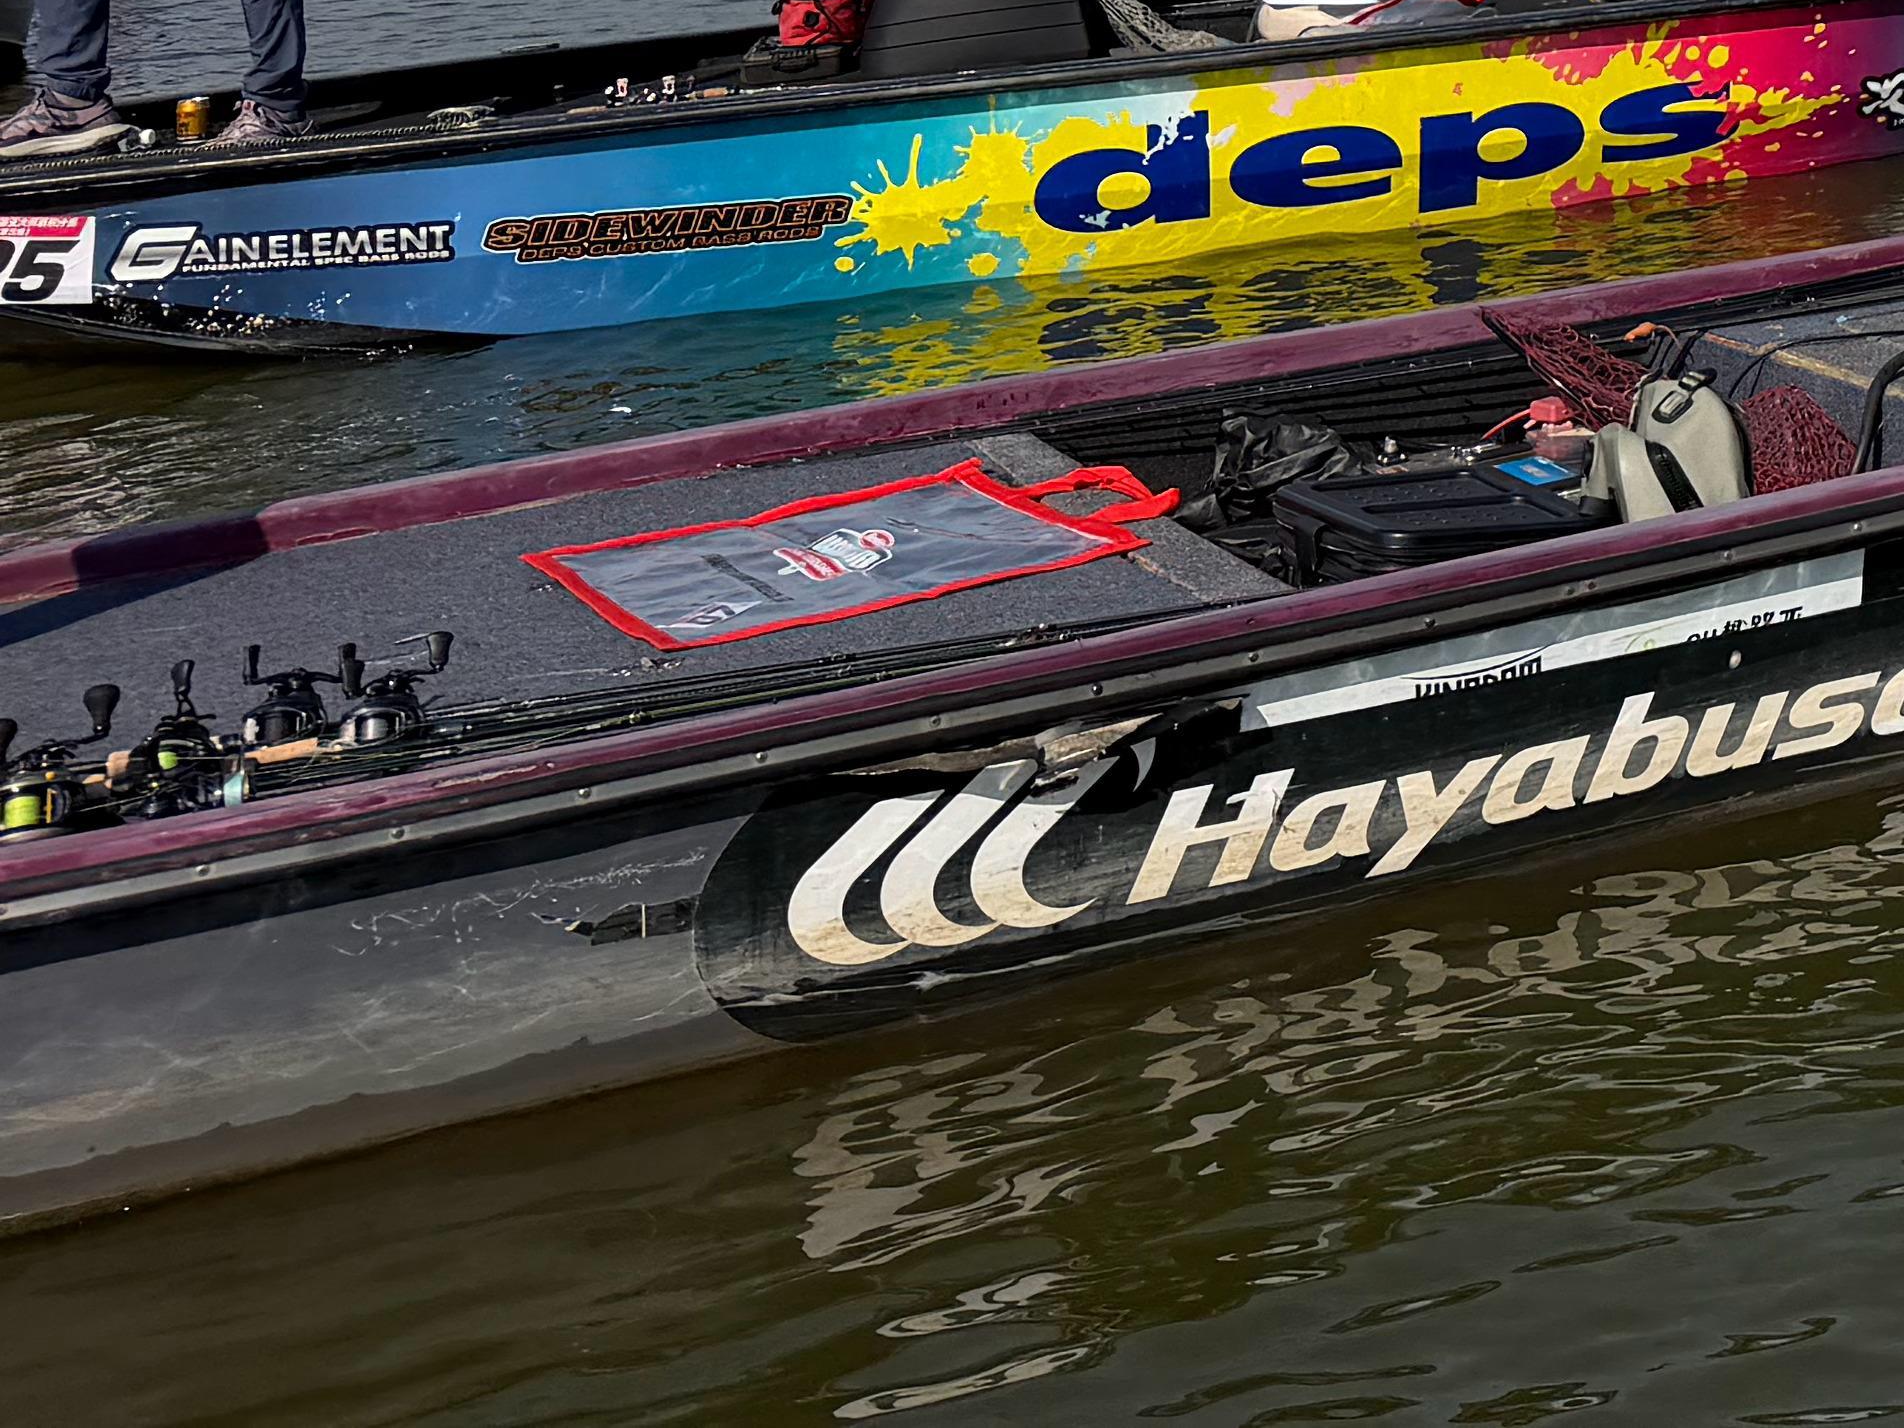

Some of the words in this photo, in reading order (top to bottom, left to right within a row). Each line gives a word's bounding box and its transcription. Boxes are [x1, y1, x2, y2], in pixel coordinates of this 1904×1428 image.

[1033, 81, 1736, 233] deps
[488, 197, 854, 249] SIDEWINDER
[182, 258, 311, 273] FUNDAMENTAL
[315, 254, 353, 265] SPEC
[358, 252, 400, 264] BASS
[405, 249, 450, 260] RODS
